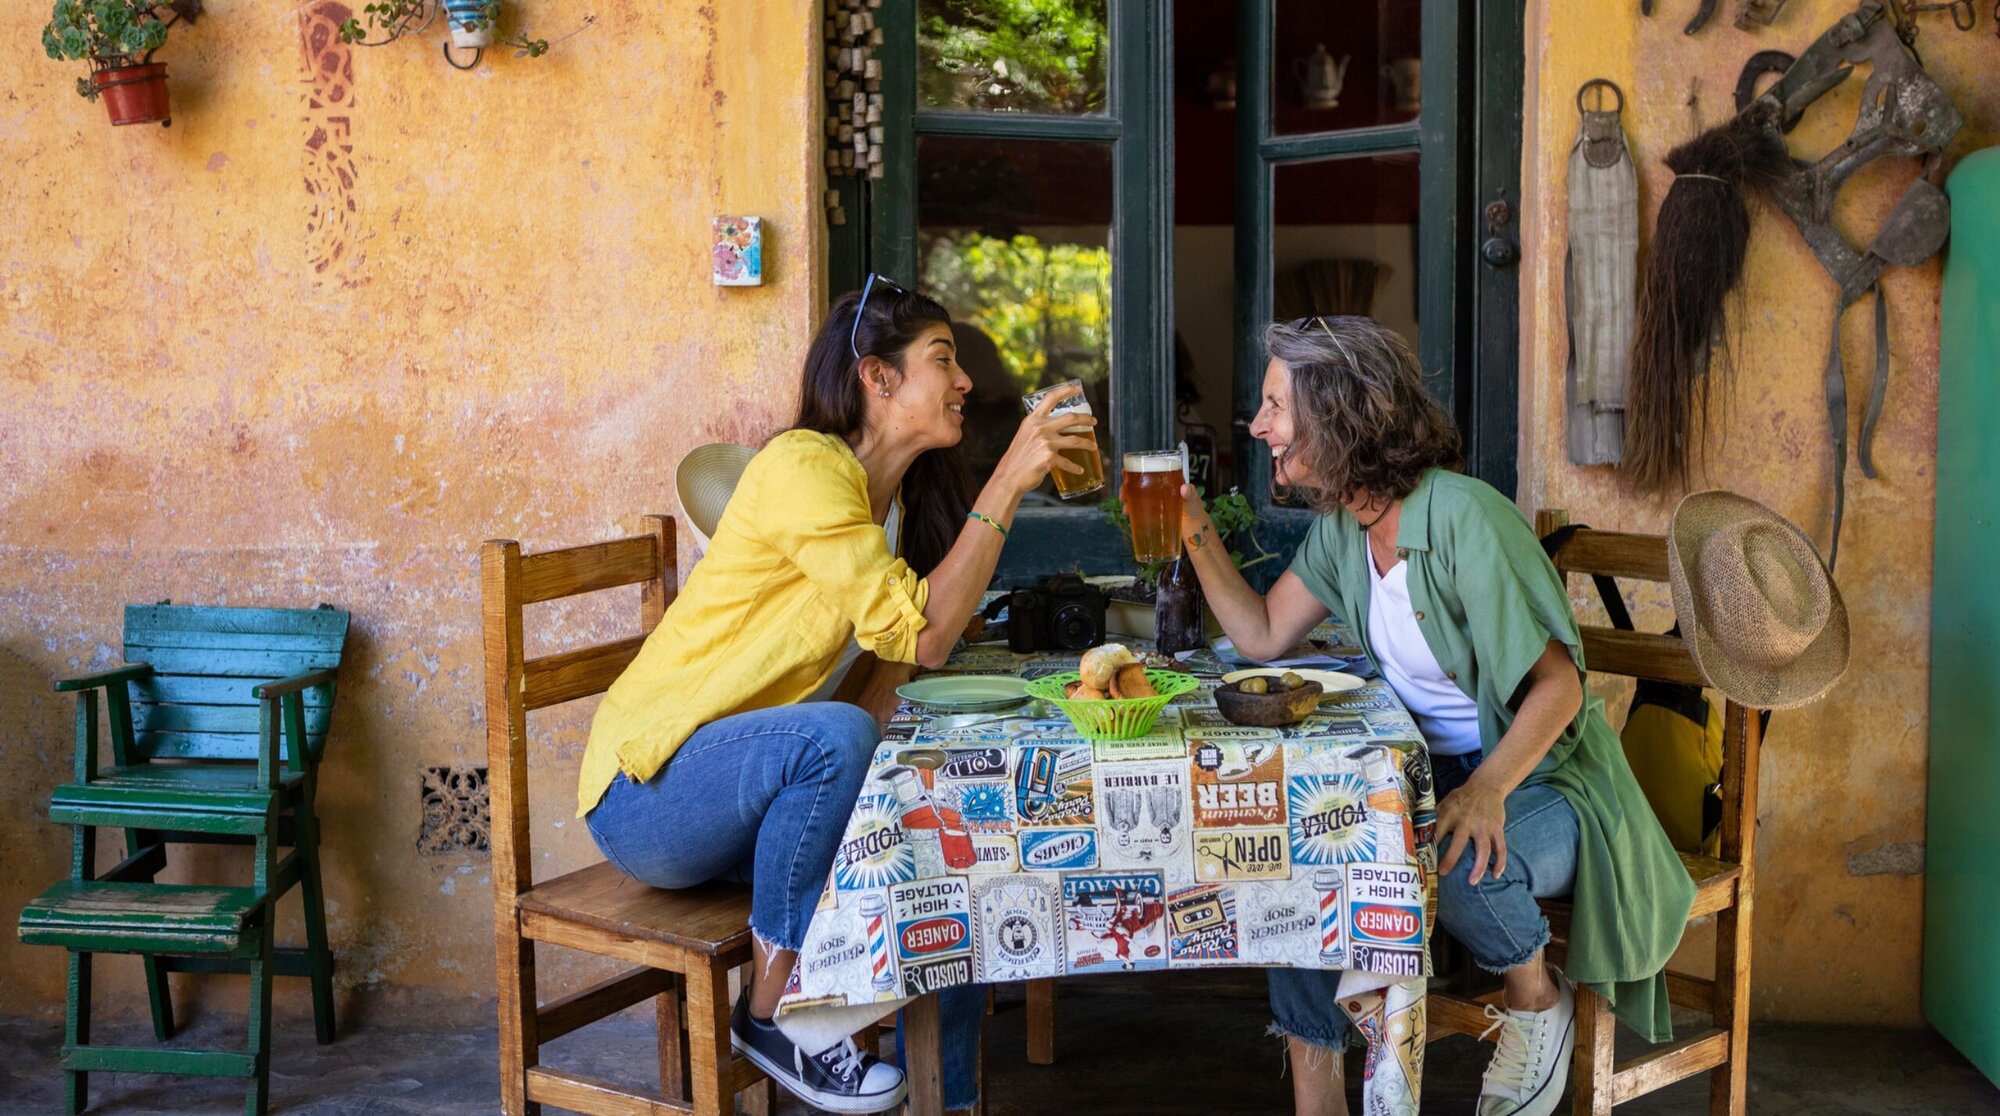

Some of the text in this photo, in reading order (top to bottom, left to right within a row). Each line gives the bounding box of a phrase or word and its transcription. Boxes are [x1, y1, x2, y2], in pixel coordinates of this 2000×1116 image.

[1201, 729, 1260, 738] SALOON
[944, 748, 1006, 778] GOLD
[1104, 775, 1158, 788] BARBIER
[1165, 774, 1179, 785] LE
[1057, 794, 1090, 811] Party
[1197, 781, 1278, 809] BEER
[1048, 805, 1082, 822] Retro
[1200, 806, 1278, 823] Premium
[1300, 800, 1369, 839] VODKA
[842, 823, 904, 866] VODKA
[1033, 835, 1085, 864] CIGARS
[1235, 836, 1282, 863] OPEN
[1245, 862, 1282, 873] we are
[1352, 869, 1420, 884] VOLTAGE
[894, 883, 964, 903] VOLTAGE
[1063, 877, 1161, 899] GARAGE
[1369, 885, 1405, 899] HIGH
[912, 899, 949, 915] HIGH
[1250, 915, 1316, 940] BARBER
[1359, 911, 1414, 932] DANGER
[906, 923, 960, 948] DANGER
[1192, 925, 1233, 944] Party
[1179, 938, 1221, 957] Retro
[808, 943, 865, 974] BARBER
[1371, 951, 1419, 976] CLOSED
[925, 960, 969, 991] CLOSED
